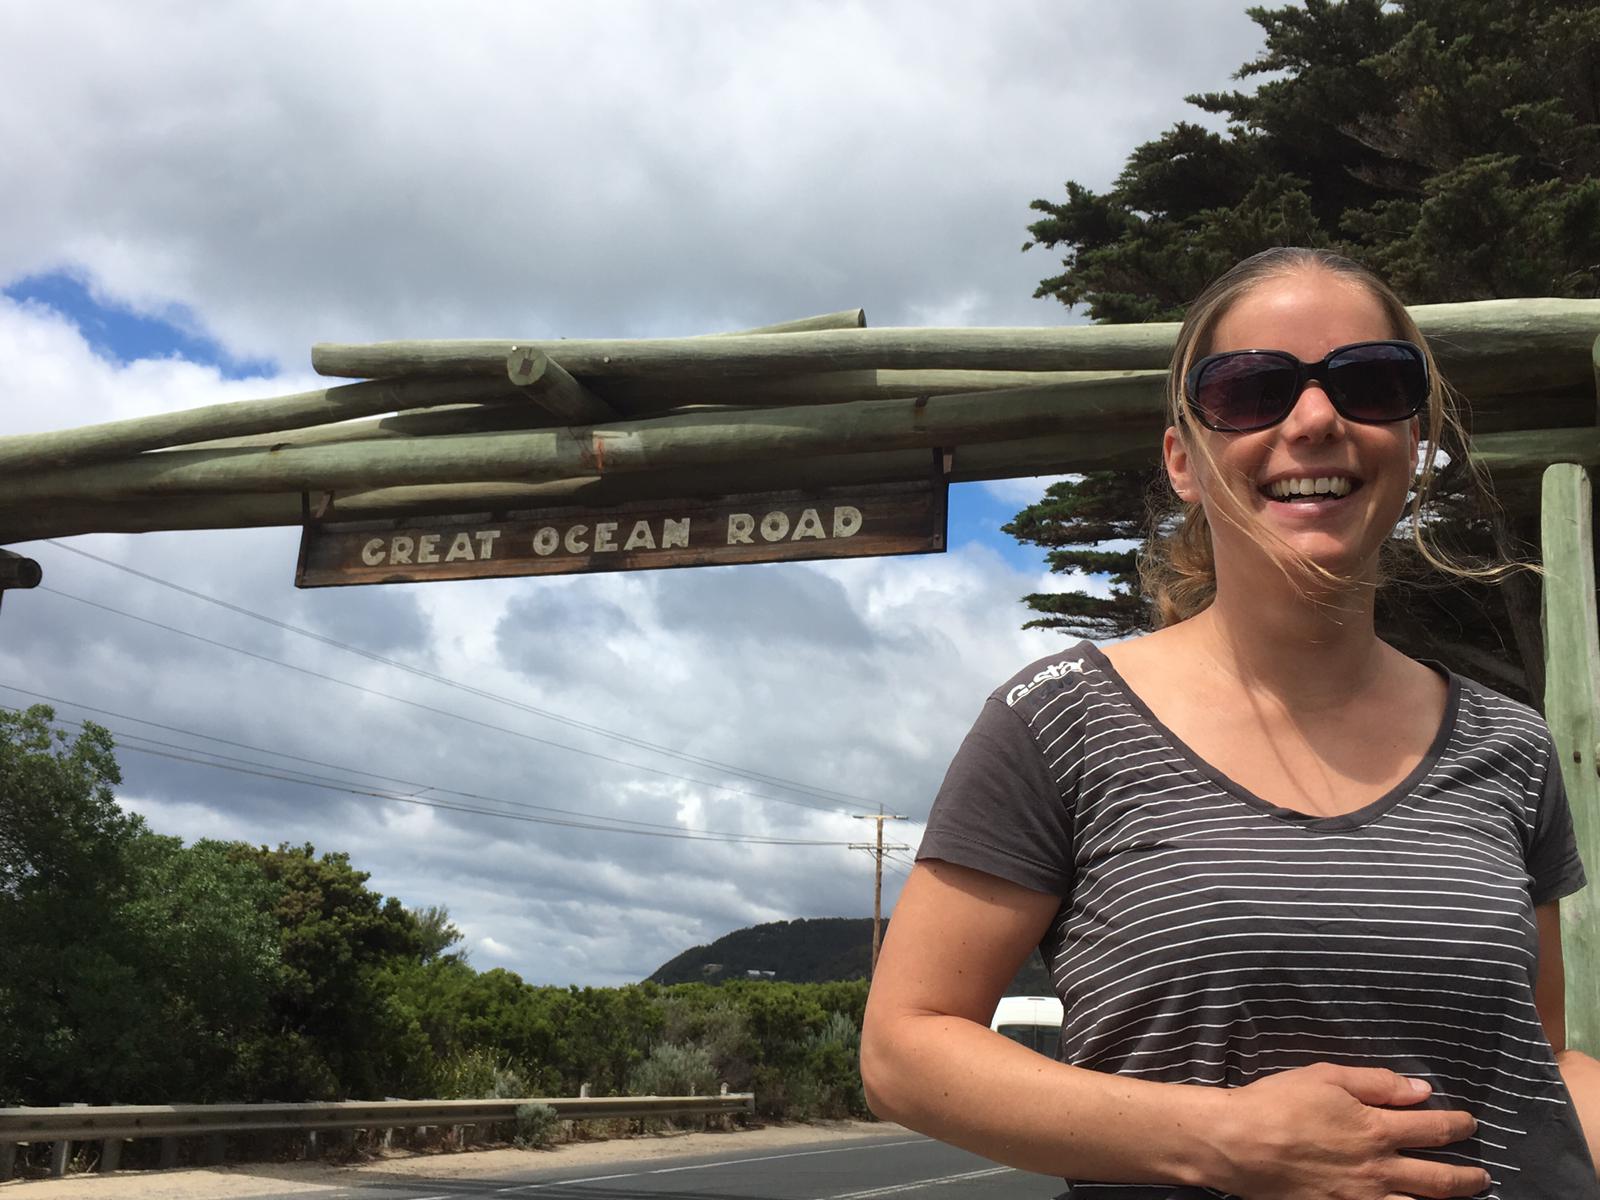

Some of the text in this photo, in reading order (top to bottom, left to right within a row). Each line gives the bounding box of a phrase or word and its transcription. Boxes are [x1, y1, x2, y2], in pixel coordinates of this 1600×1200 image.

[362, 506, 863, 566] GREAT OCEAN ROAD
